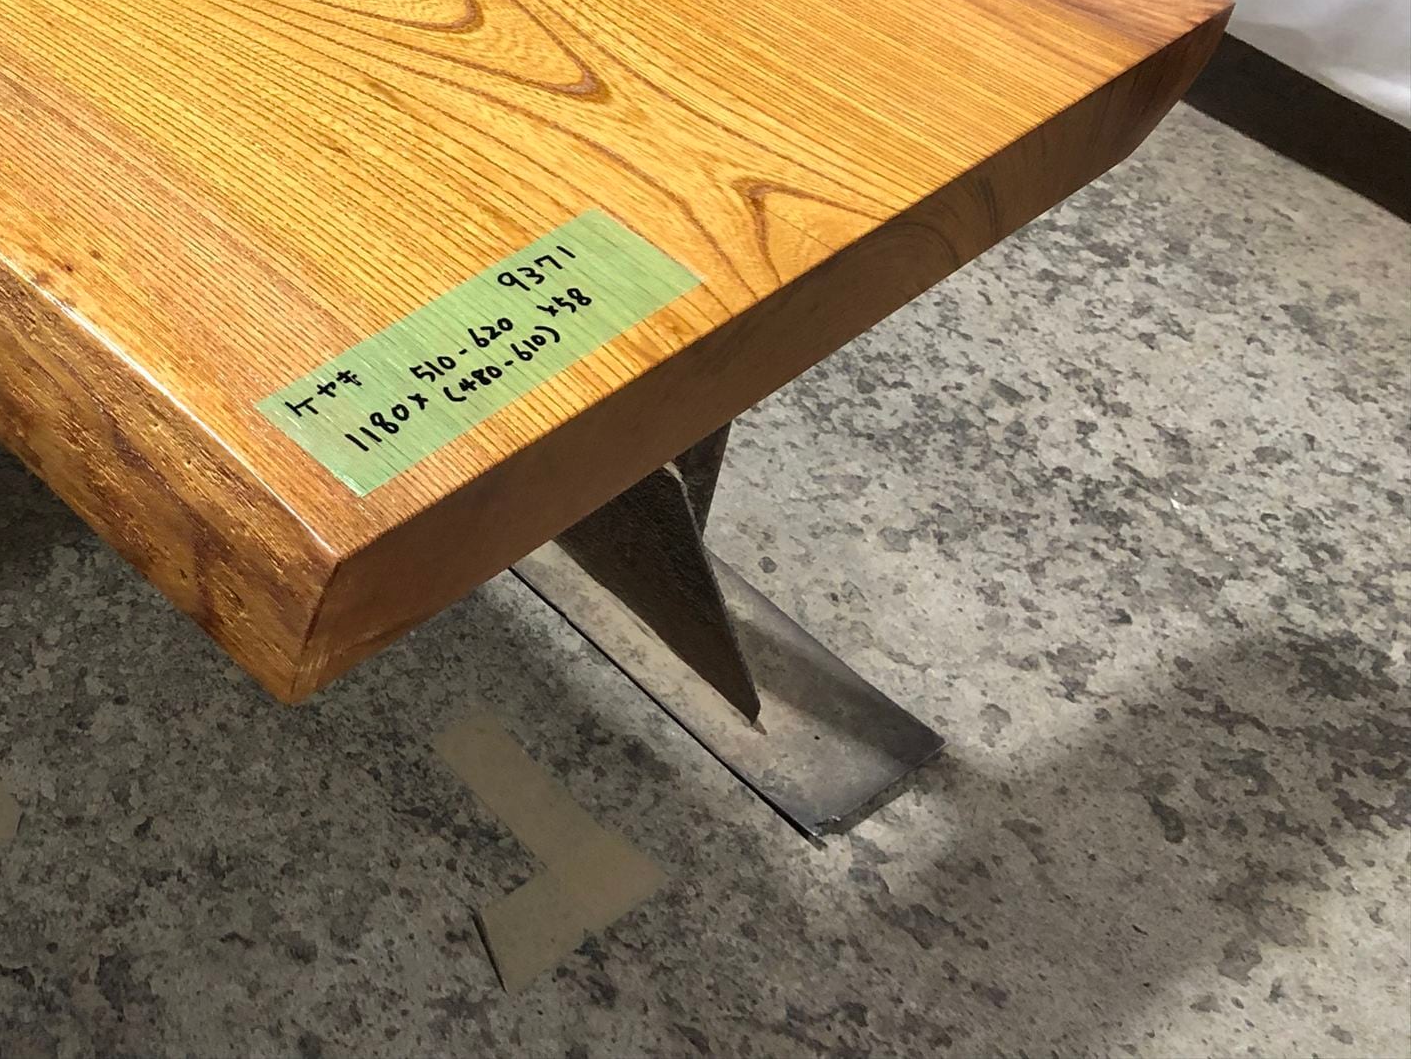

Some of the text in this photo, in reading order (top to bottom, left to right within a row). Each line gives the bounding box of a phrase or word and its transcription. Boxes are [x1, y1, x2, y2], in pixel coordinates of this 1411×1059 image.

[497, 245, 576, 291] 9371
[284, 369, 363, 418] ケヤキ
